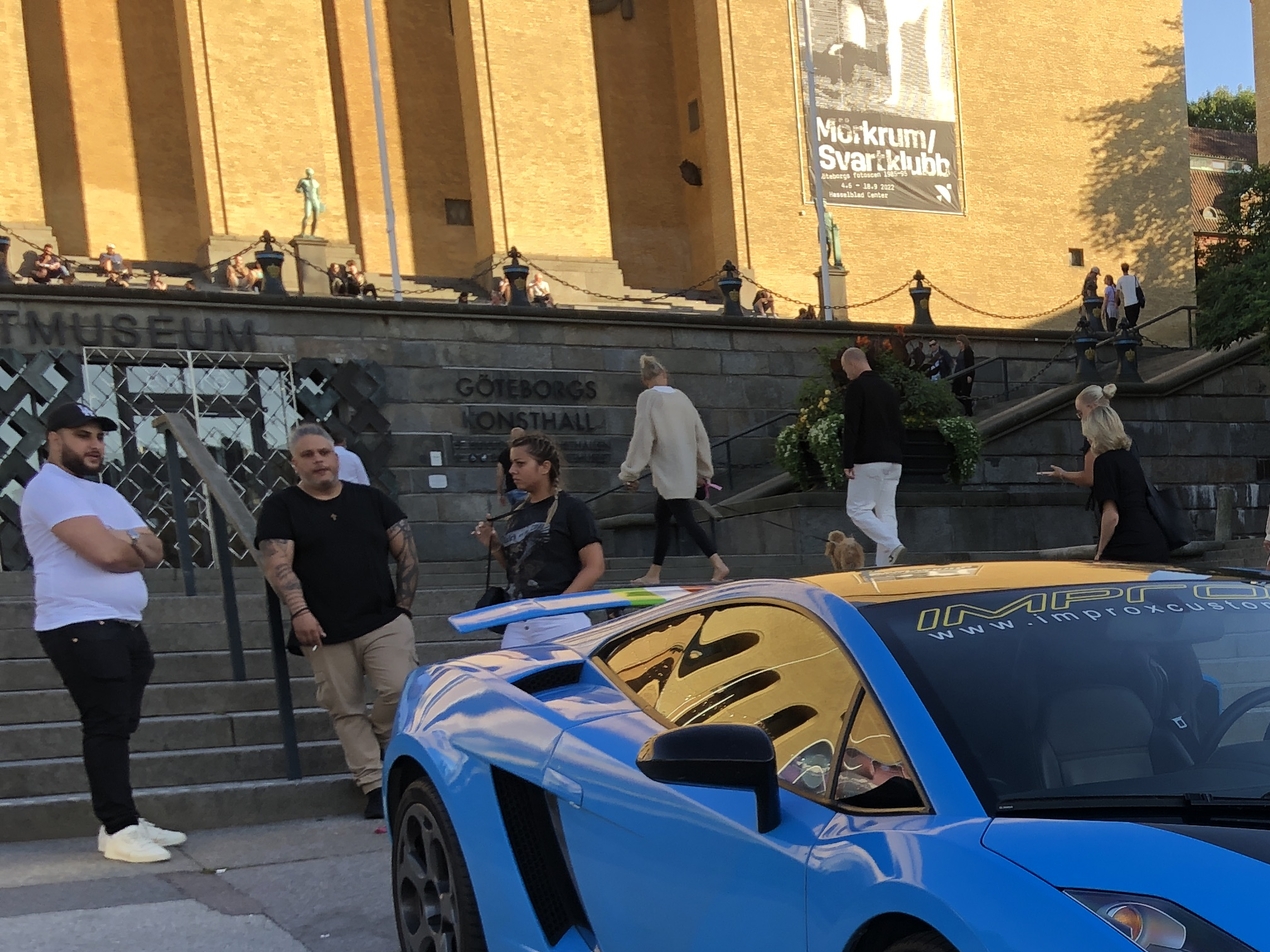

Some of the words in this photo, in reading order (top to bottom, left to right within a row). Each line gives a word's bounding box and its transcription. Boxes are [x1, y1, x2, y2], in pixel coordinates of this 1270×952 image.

[815, 116, 937, 154] Mörkrum/
[818, 144, 951, 178] Svartklubb
[828, 190, 865, 199] Hasselblad
[867, 191, 889, 199] Center
[456, 374, 597, 399] GÖTEBORGS
[462, 410, 595, 431] KONSTHALL
